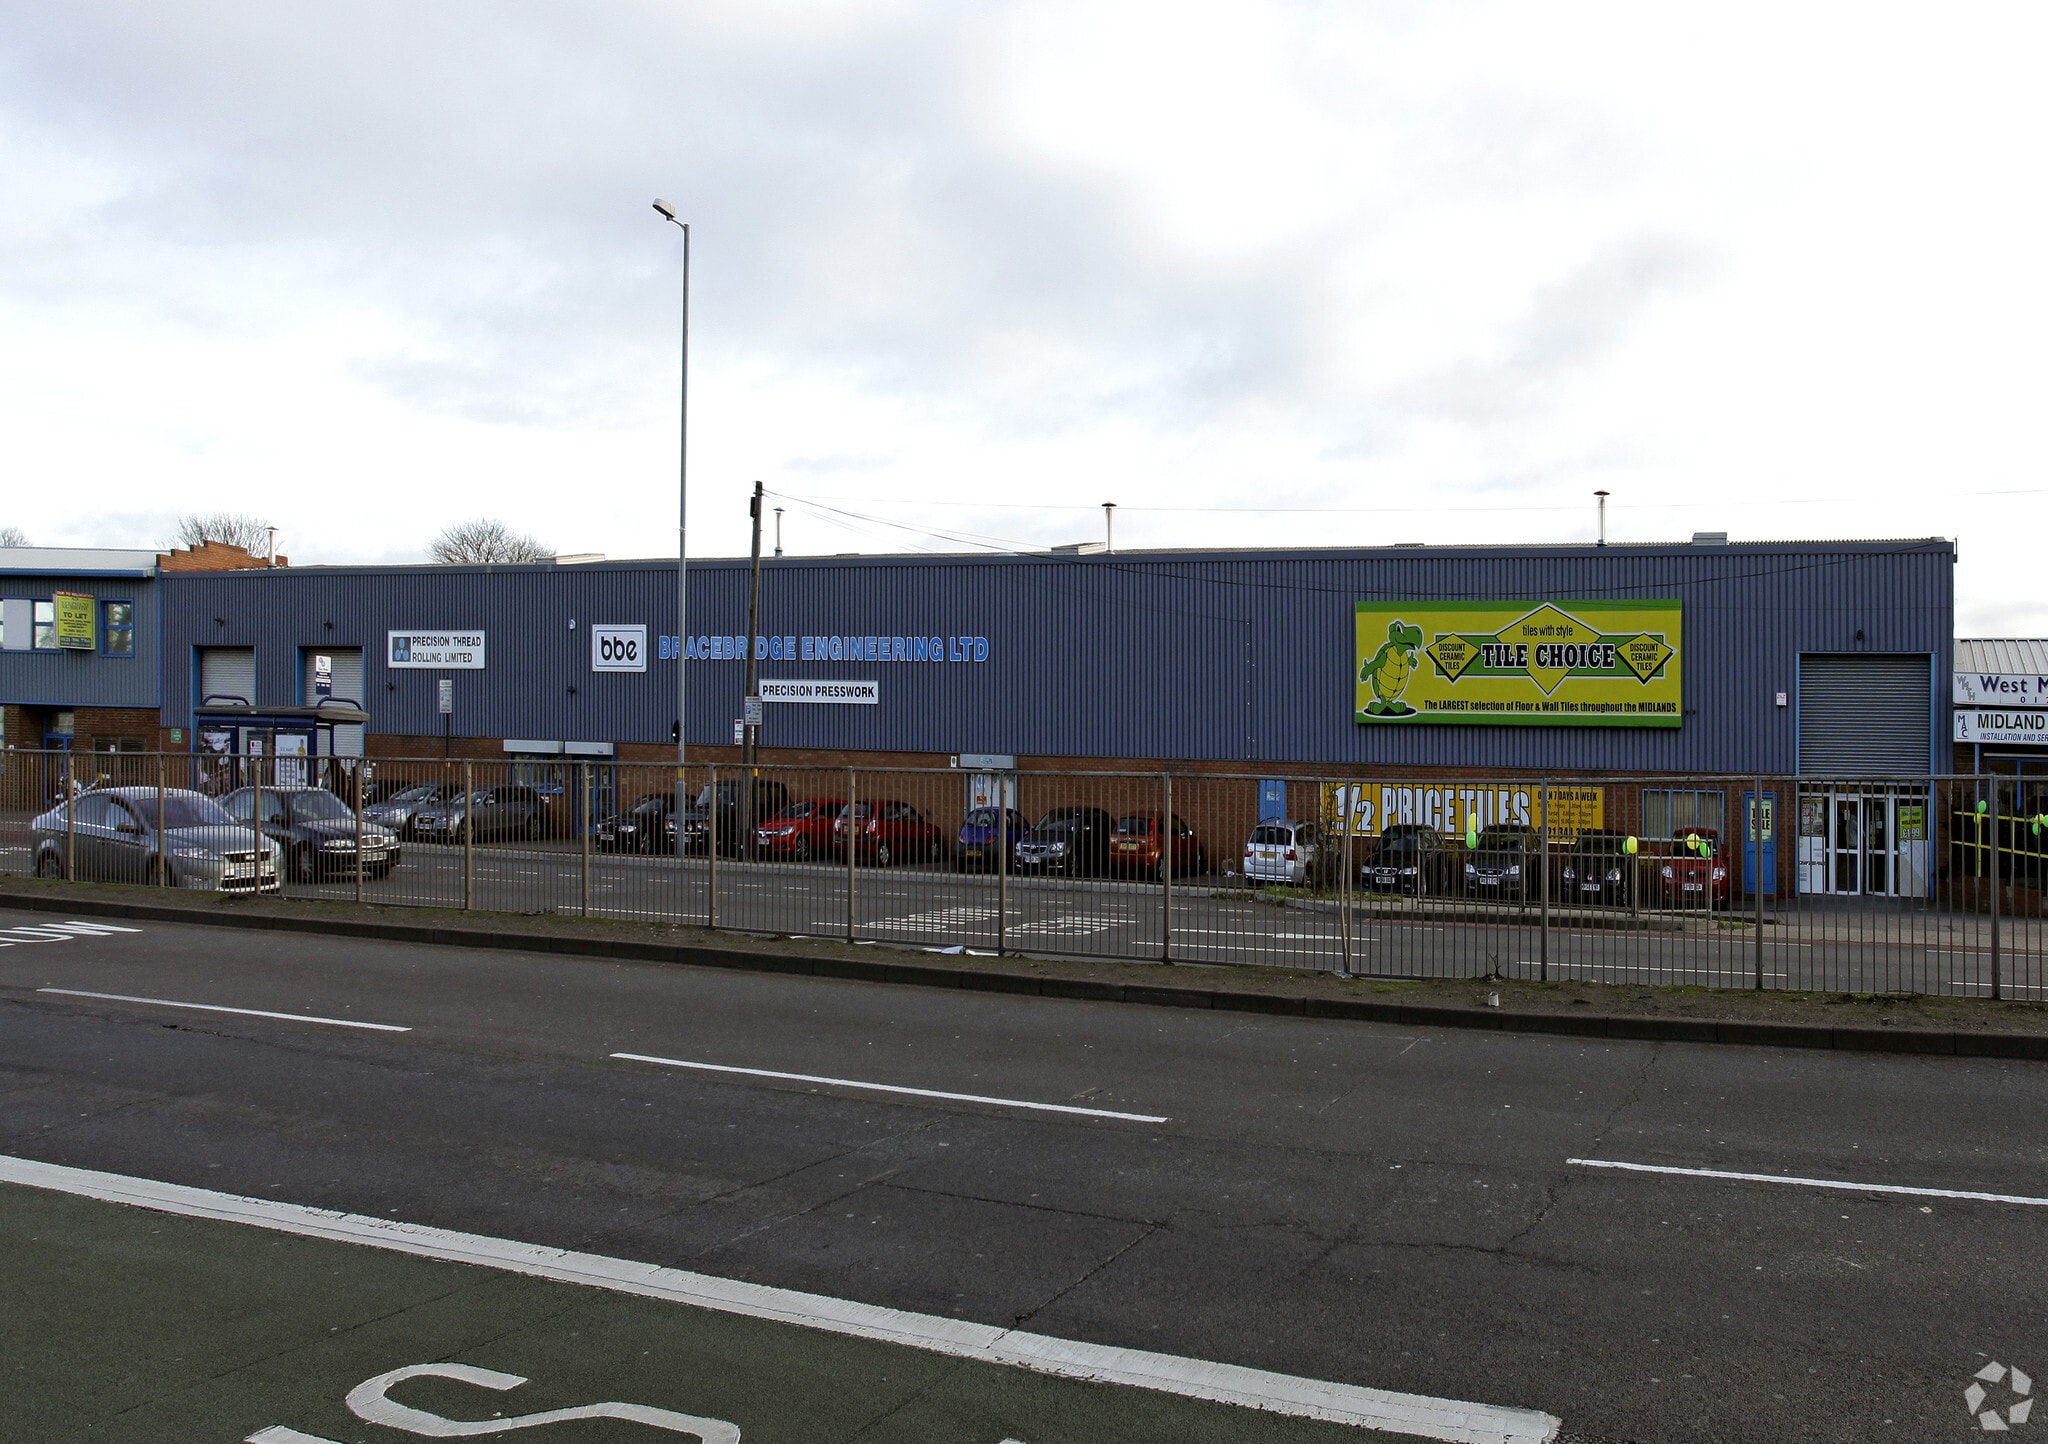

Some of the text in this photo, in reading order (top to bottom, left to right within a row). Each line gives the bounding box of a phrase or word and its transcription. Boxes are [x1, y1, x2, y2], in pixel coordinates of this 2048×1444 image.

[1522, 624, 1573, 638] tiles with style
[412, 636, 481, 647] PRECISION THREAD
[600, 636, 637, 661] bbe
[658, 636, 989, 662] BRACEBRDGE ENGINEERING LTD
[1438, 644, 1466, 652] DISCOUNT
[1630, 644, 1658, 652] DISCOUNT
[412, 652, 472, 662] ROLLING LIMITED
[1482, 644, 1616, 668] TILE CHOICE
[1630, 653, 1658, 661] CERAMIC
[1445, 662, 1460, 670] TILES
[1636, 662, 1652, 670] TILES
[1980, 676, 2028, 693] West
[762, 684, 874, 698] PRECISION PRESSWORK
[1424, 700, 1676, 713] The LARGEST selection of Floor & Wall Tiles throughout the MIDLANDS
[1978, 714, 2045, 730] MIDLAND
[1980, 732, 2020, 740] INSTALLATION
[1558, 792, 1574, 800] DAYS
[1575, 792, 1580, 800] A
[1381, 787, 1455, 832] PRICE
[1459, 790, 1531, 832] TILES
[1752, 808, 1770, 818] TLE
[1752, 820, 1770, 830] SLE
[0, 921, 143, 947] OW
